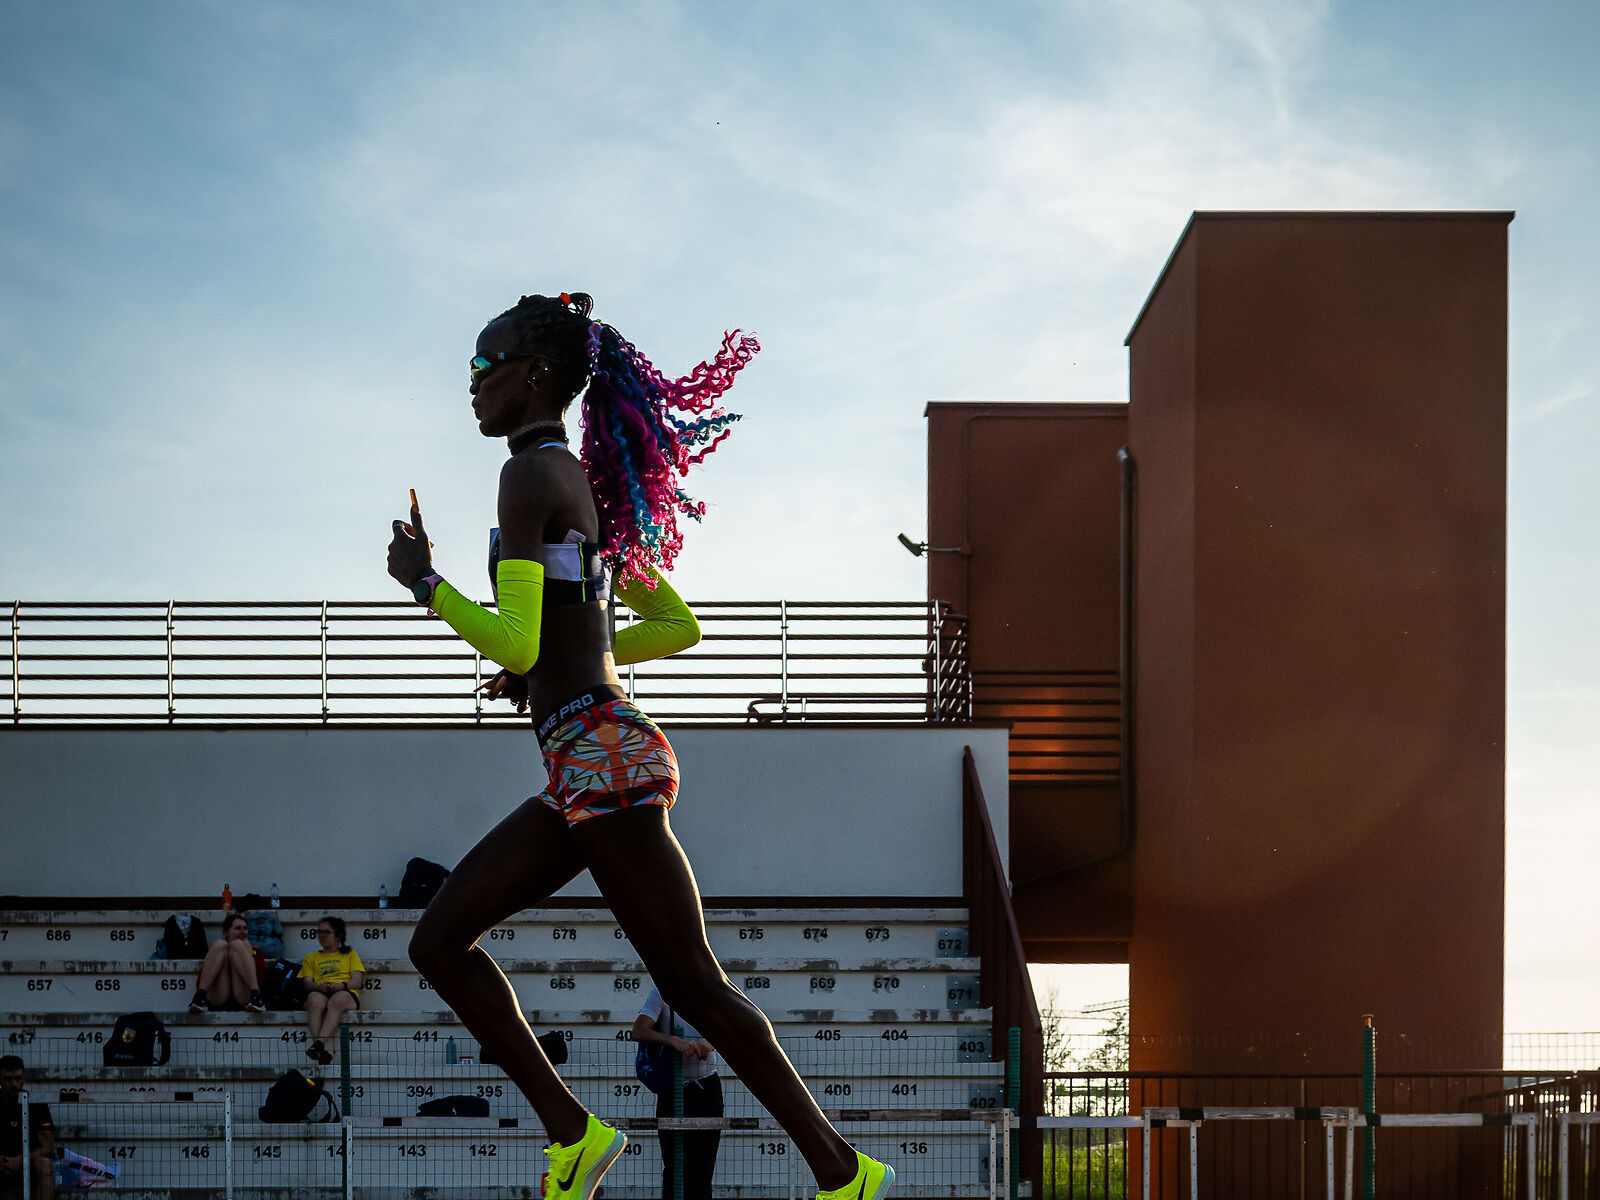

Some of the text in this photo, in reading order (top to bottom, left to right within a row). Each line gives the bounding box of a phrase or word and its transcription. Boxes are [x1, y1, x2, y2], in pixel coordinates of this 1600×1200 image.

[559, 693, 596, 719] PRO
[46, 930, 71, 941] 686
[110, 930, 135, 941] 685
[301, 929, 317, 939] 68
[363, 929, 387, 940] 681
[490, 929, 515, 940] 679
[553, 929, 577, 940] 678
[739, 928, 763, 939] 675
[803, 928, 828, 939] 674
[865, 928, 890, 939] 673
[937, 939, 962, 950] 672
[27, 979, 53, 991] 657
[95, 979, 120, 991] 658
[161, 979, 186, 990] 659
[550, 978, 575, 989] 665
[614, 978, 640, 989] 666
[746, 978, 770, 989] 668
[810, 978, 835, 989] 669
[874, 978, 899, 989] 670
[948, 989, 972, 1000] 671
[8, 1032, 34, 1044] 417
[77, 1032, 103, 1043] 416
[212, 1031, 239, 1043] 414
[281, 1031, 307, 1042] 413
[349, 1031, 373, 1043] 412
[413, 1030, 438, 1042] 411
[615, 1030, 632, 1042] 40
[814, 1029, 841, 1041] 405
[881, 1029, 908, 1041] 404
[958, 1041, 985, 1053] 403
[407, 1085, 434, 1097] 394
[476, 1085, 503, 1097] 395
[614, 1085, 641, 1097] 397
[824, 1084, 851, 1095] 400
[891, 1084, 917, 1095] 401
[969, 1097, 996, 1109] 402
[108, 1146, 136, 1158] 147
[182, 1145, 210, 1158] 146
[254, 1145, 281, 1158] 145
[398, 1144, 426, 1157] 143
[469, 1144, 497, 1156] 142
[758, 1142, 786, 1155] 138
[900, 1142, 928, 1154] 136
